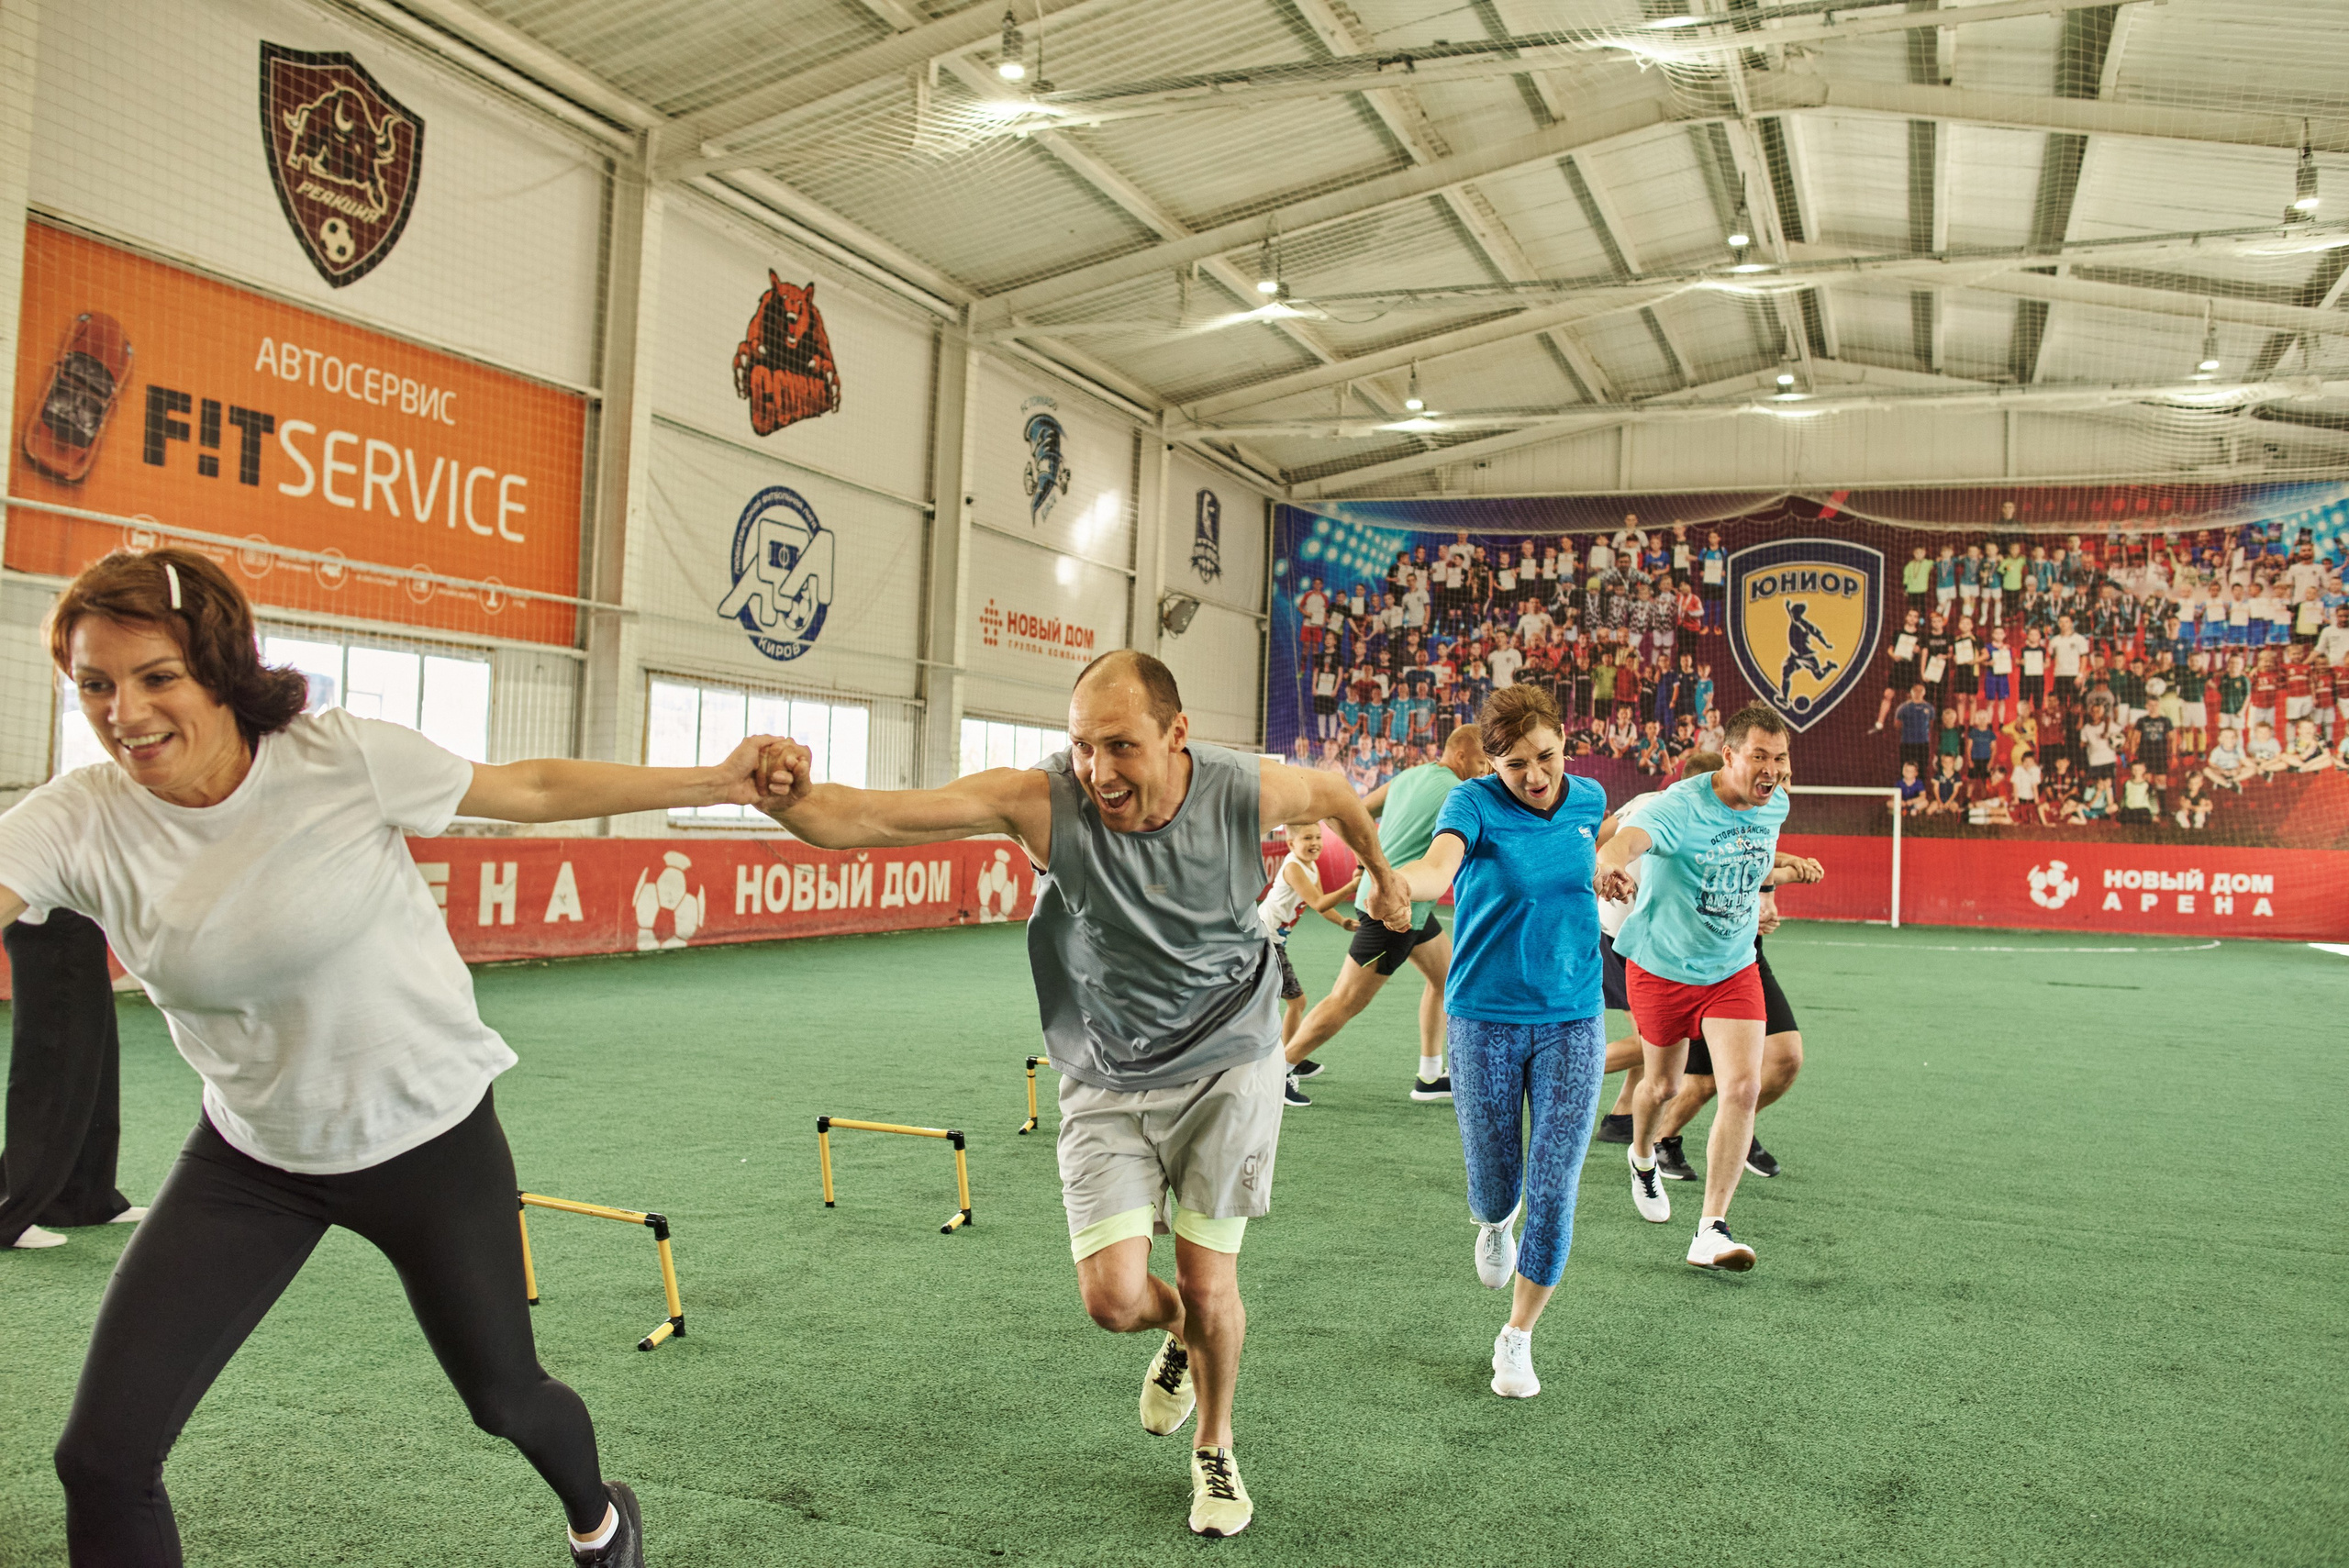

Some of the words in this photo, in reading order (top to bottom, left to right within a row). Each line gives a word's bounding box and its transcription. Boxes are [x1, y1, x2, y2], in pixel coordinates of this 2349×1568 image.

[255, 337, 457, 426] АВТОСЕРВИС
[278, 418, 529, 543] SERVICE
[1750, 571, 1860, 602] ЮНИОР
[1007, 610, 1061, 644] НОВЫЙ
[1064, 624, 1094, 650] ДОМ
[758, 636, 801, 658] КИРОВ
[1710, 827, 1740, 846] OCTOPUS
[735, 852, 874, 915] НОВЫЙ
[881, 861, 951, 909] ДОМ
[2103, 868, 2205, 892] НОВЫЙ
[2210, 873, 2275, 895] ДОМ
[2101, 891, 2275, 917] АРЕНА
